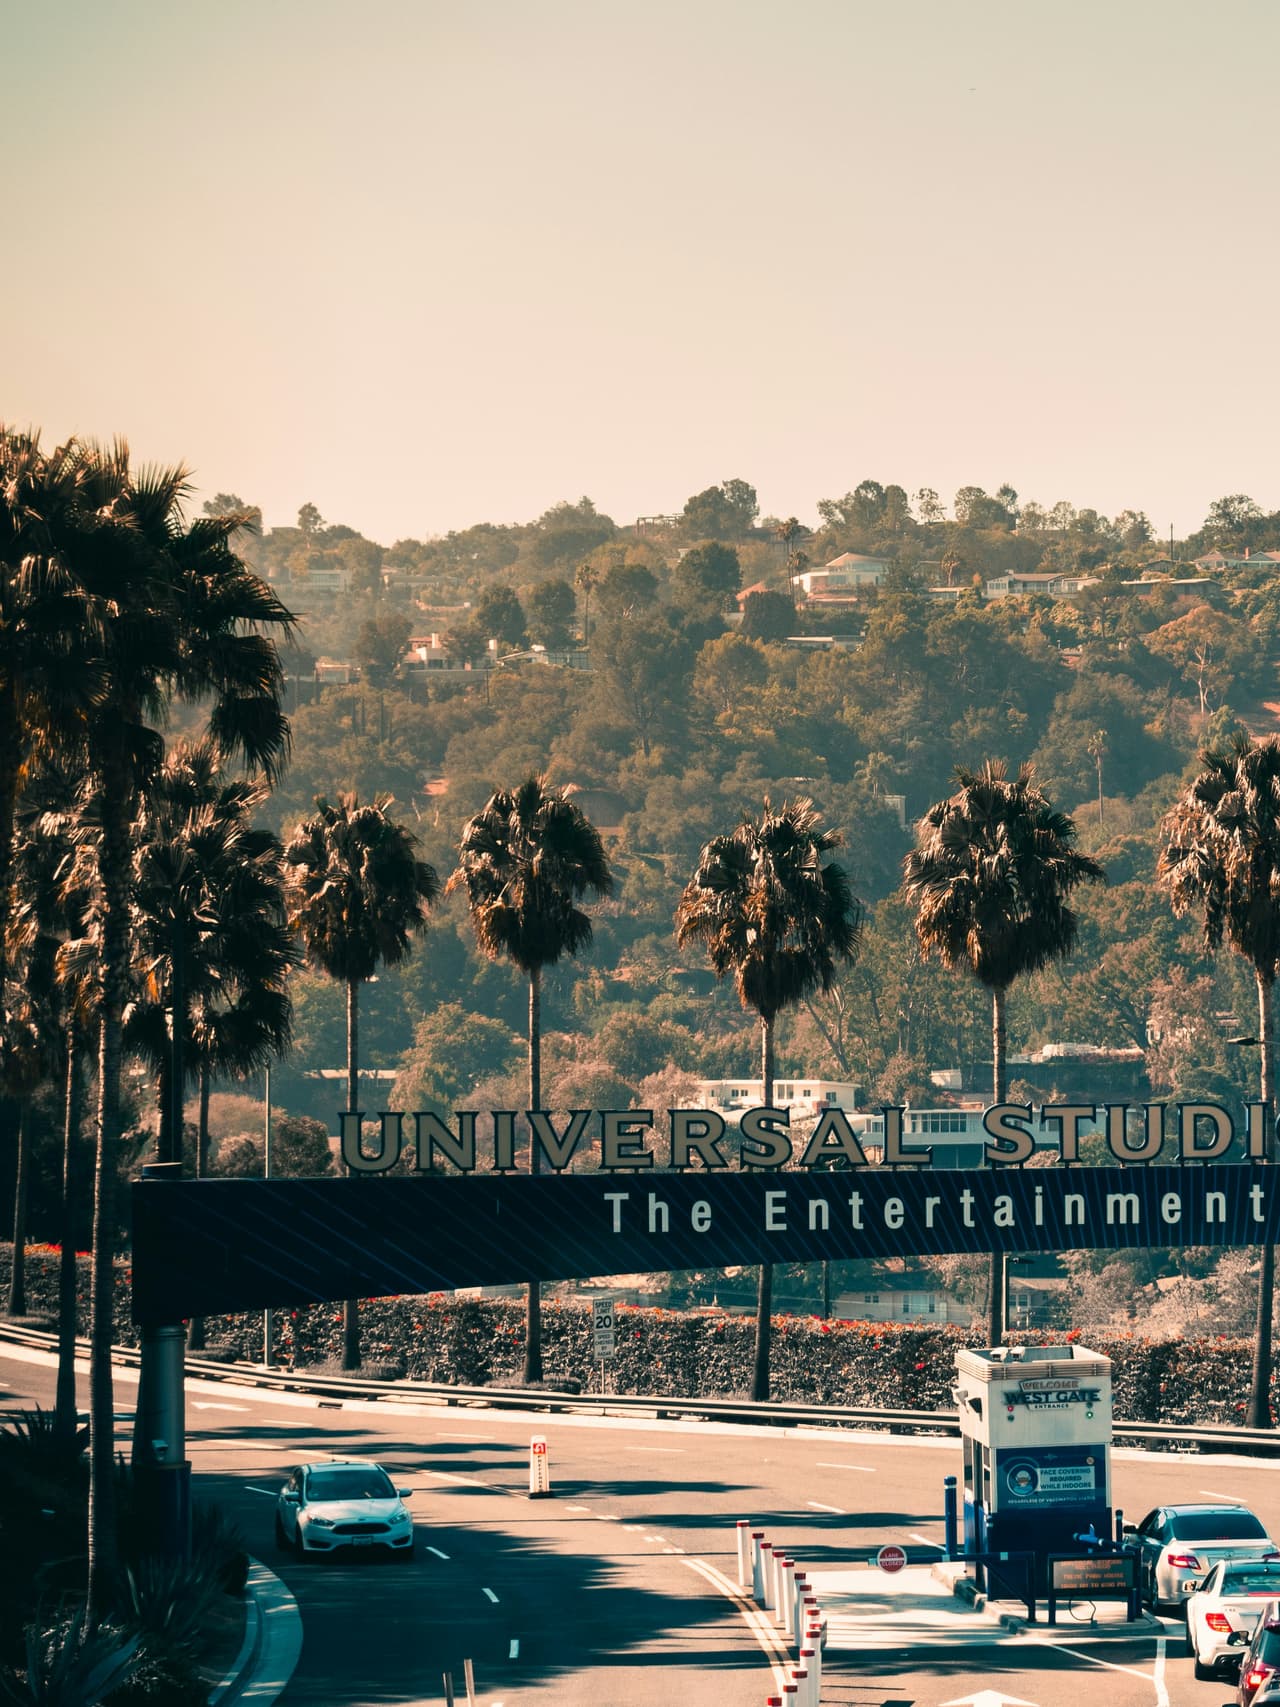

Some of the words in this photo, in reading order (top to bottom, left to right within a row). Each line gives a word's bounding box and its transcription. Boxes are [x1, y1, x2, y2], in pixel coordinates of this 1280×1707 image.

[338, 1105, 932, 1174] UNIVERSAL
[604, 1192, 712, 1233] The
[765, 1184, 1266, 1232] Entertainment
[596, 1315, 612, 1329] 20
[1022, 1380, 1078, 1390] WELCOME
[1004, 1391, 1050, 1405] WEST
[1055, 1389, 1100, 1402] GATE
[1058, 1467, 1091, 1475] COVERING
